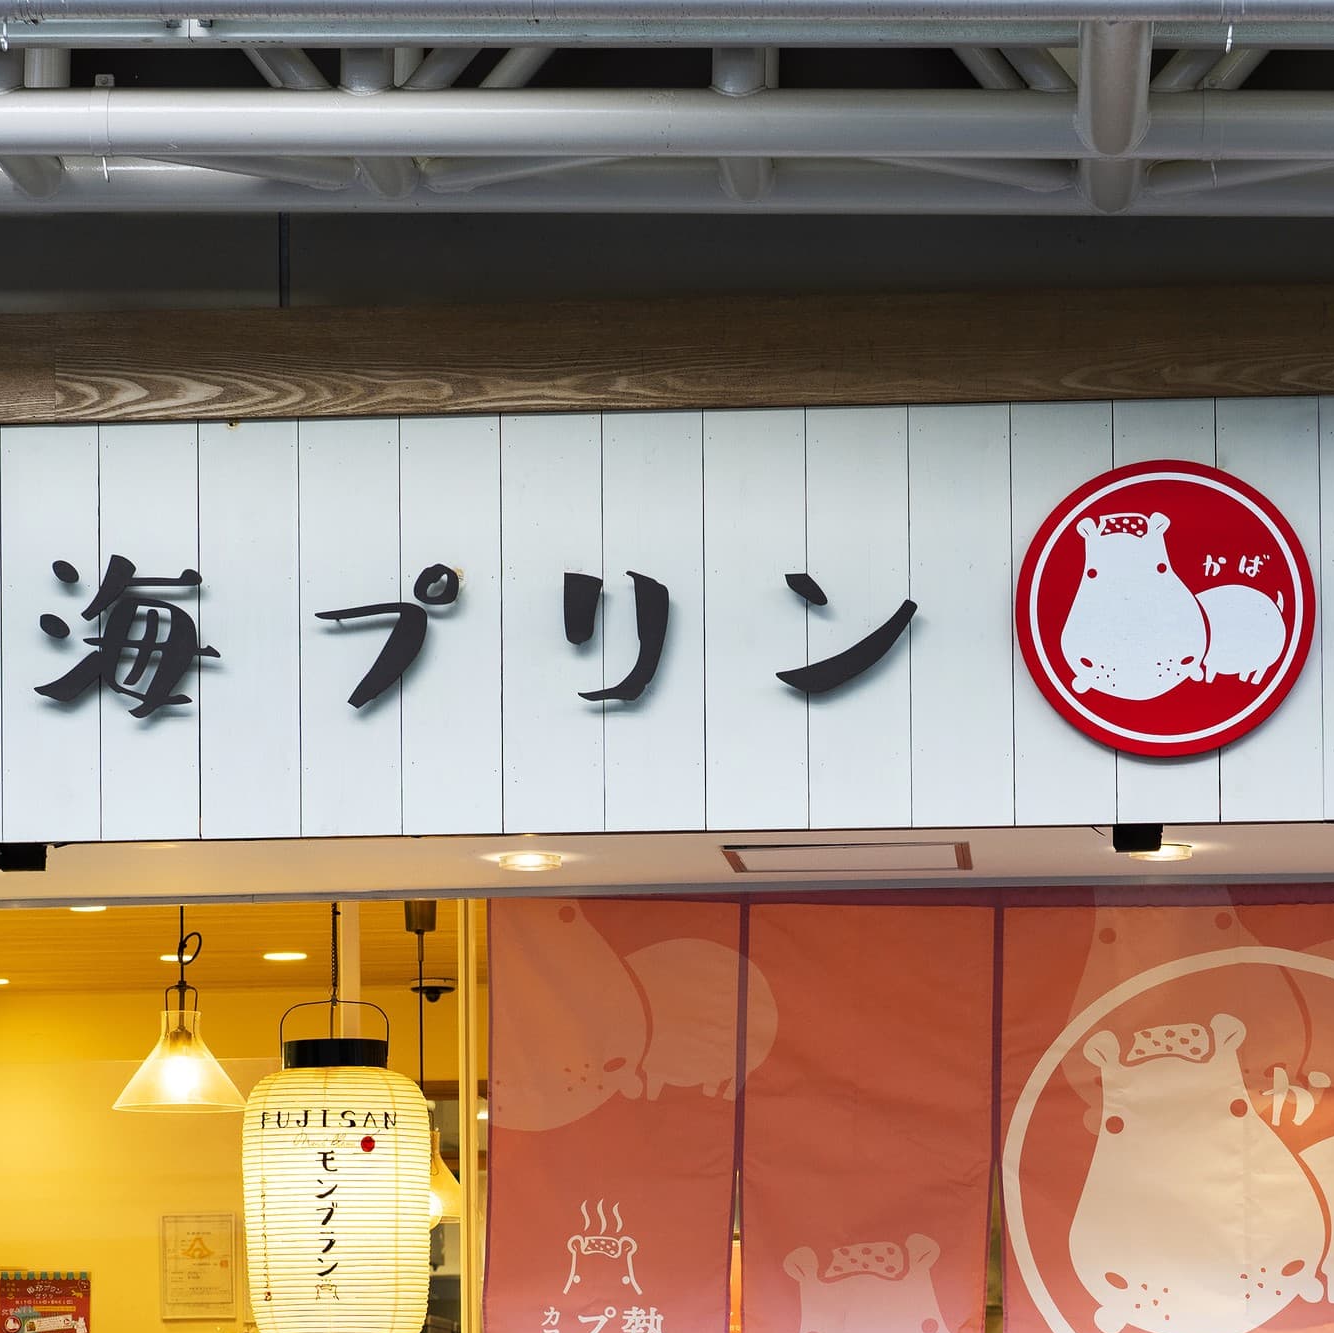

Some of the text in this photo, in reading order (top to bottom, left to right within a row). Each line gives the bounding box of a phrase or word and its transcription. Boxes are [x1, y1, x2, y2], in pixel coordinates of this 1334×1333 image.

[1202, 553, 1271, 579] かば
[259, 1110, 398, 1130] FUJISAN
[314, 1150, 339, 1277] モンブラン
